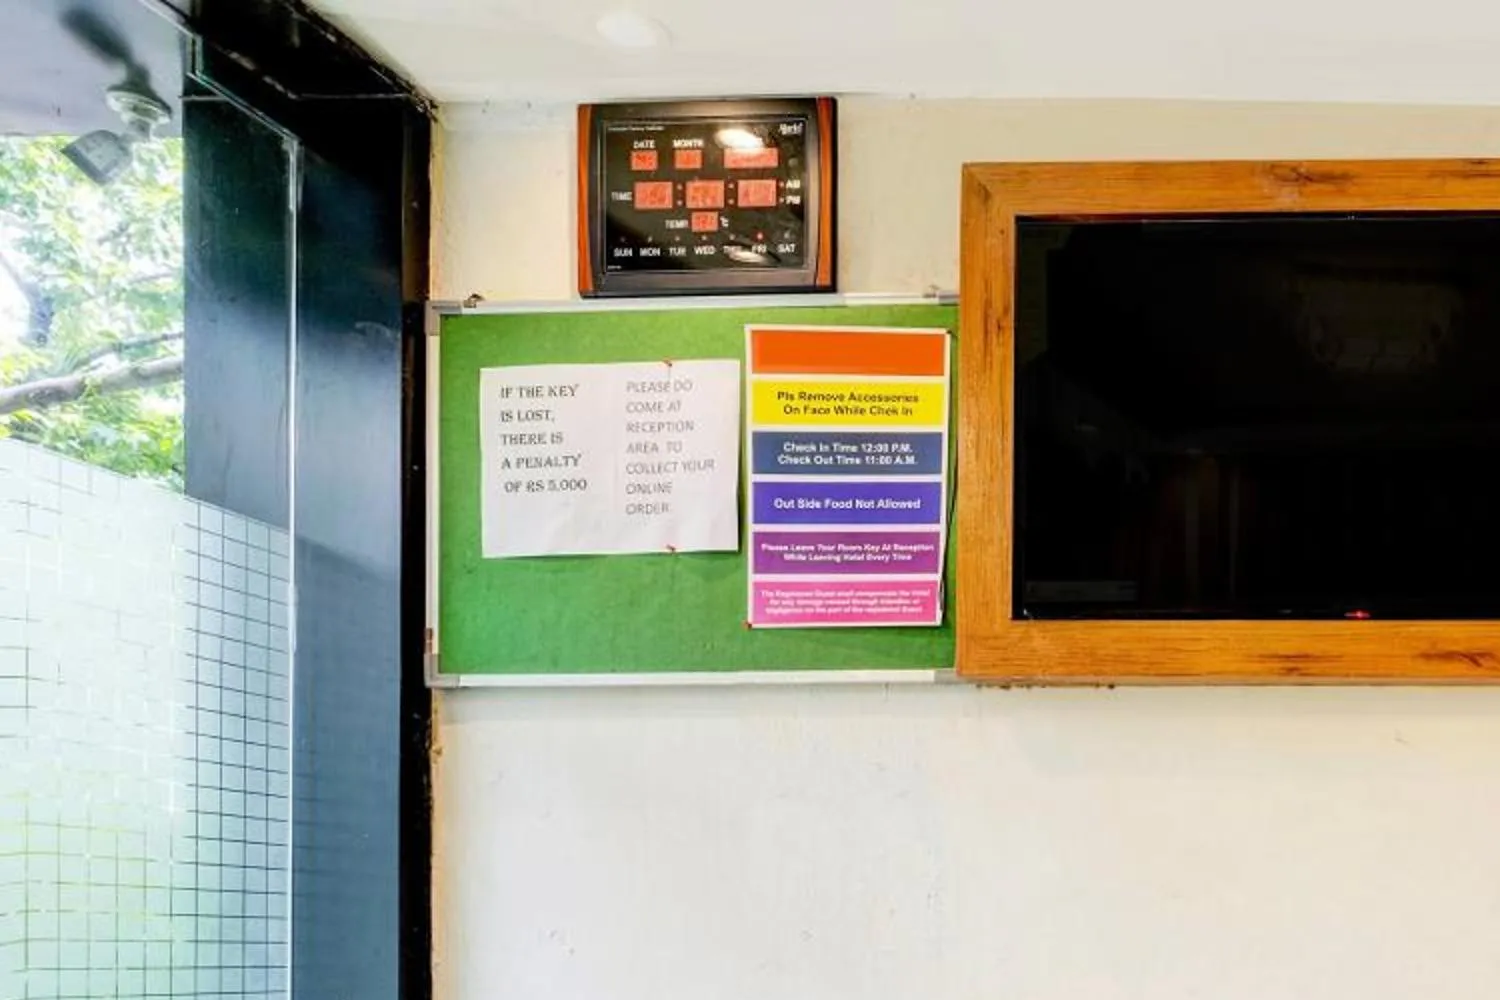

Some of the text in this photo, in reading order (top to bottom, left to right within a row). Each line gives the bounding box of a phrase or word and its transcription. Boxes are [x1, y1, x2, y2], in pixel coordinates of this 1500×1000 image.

[633, 139, 704, 149] DATE MONTH
[611, 192, 632, 201] TIME
[613, 247, 633, 257] SUN
[639, 247, 661, 257] MON
[694, 246, 716, 255] WED
[777, 244, 796, 254] SAT
[500, 384, 580, 398] IF THE KEY
[626, 379, 693, 393] PLEASE DO
[777, 391, 919, 403] Pls Remove Accessories
[626, 400, 682, 413] COME AT
[783, 405, 801, 415] On
[803, 405, 830, 415] Face
[834, 405, 866, 416] While
[901, 406, 913, 416] In
[500, 410, 513, 422] IS
[626, 420, 694, 433] RECEPTION
[500, 431, 563, 446] THERE IS
[626, 440, 683, 454] AREA TO
[783, 442, 817, 452] Check
[819, 442, 830, 452] In
[832, 442, 858, 452] Time
[861, 442, 889, 452] 12:00
[501, 454, 582, 469] A PENALTY
[777, 454, 811, 465] Check
[814, 454, 834, 465] Out
[836, 455, 861, 465] Time
[625, 459, 715, 475] COLLECT YOUR
[504, 481, 521, 493] OF
[526, 480, 545, 492] RS
[625, 482, 673, 494] ONLINE
[625, 503, 671, 515] ORDER
[773, 498, 921, 509] Out Side Food Not Allowed
